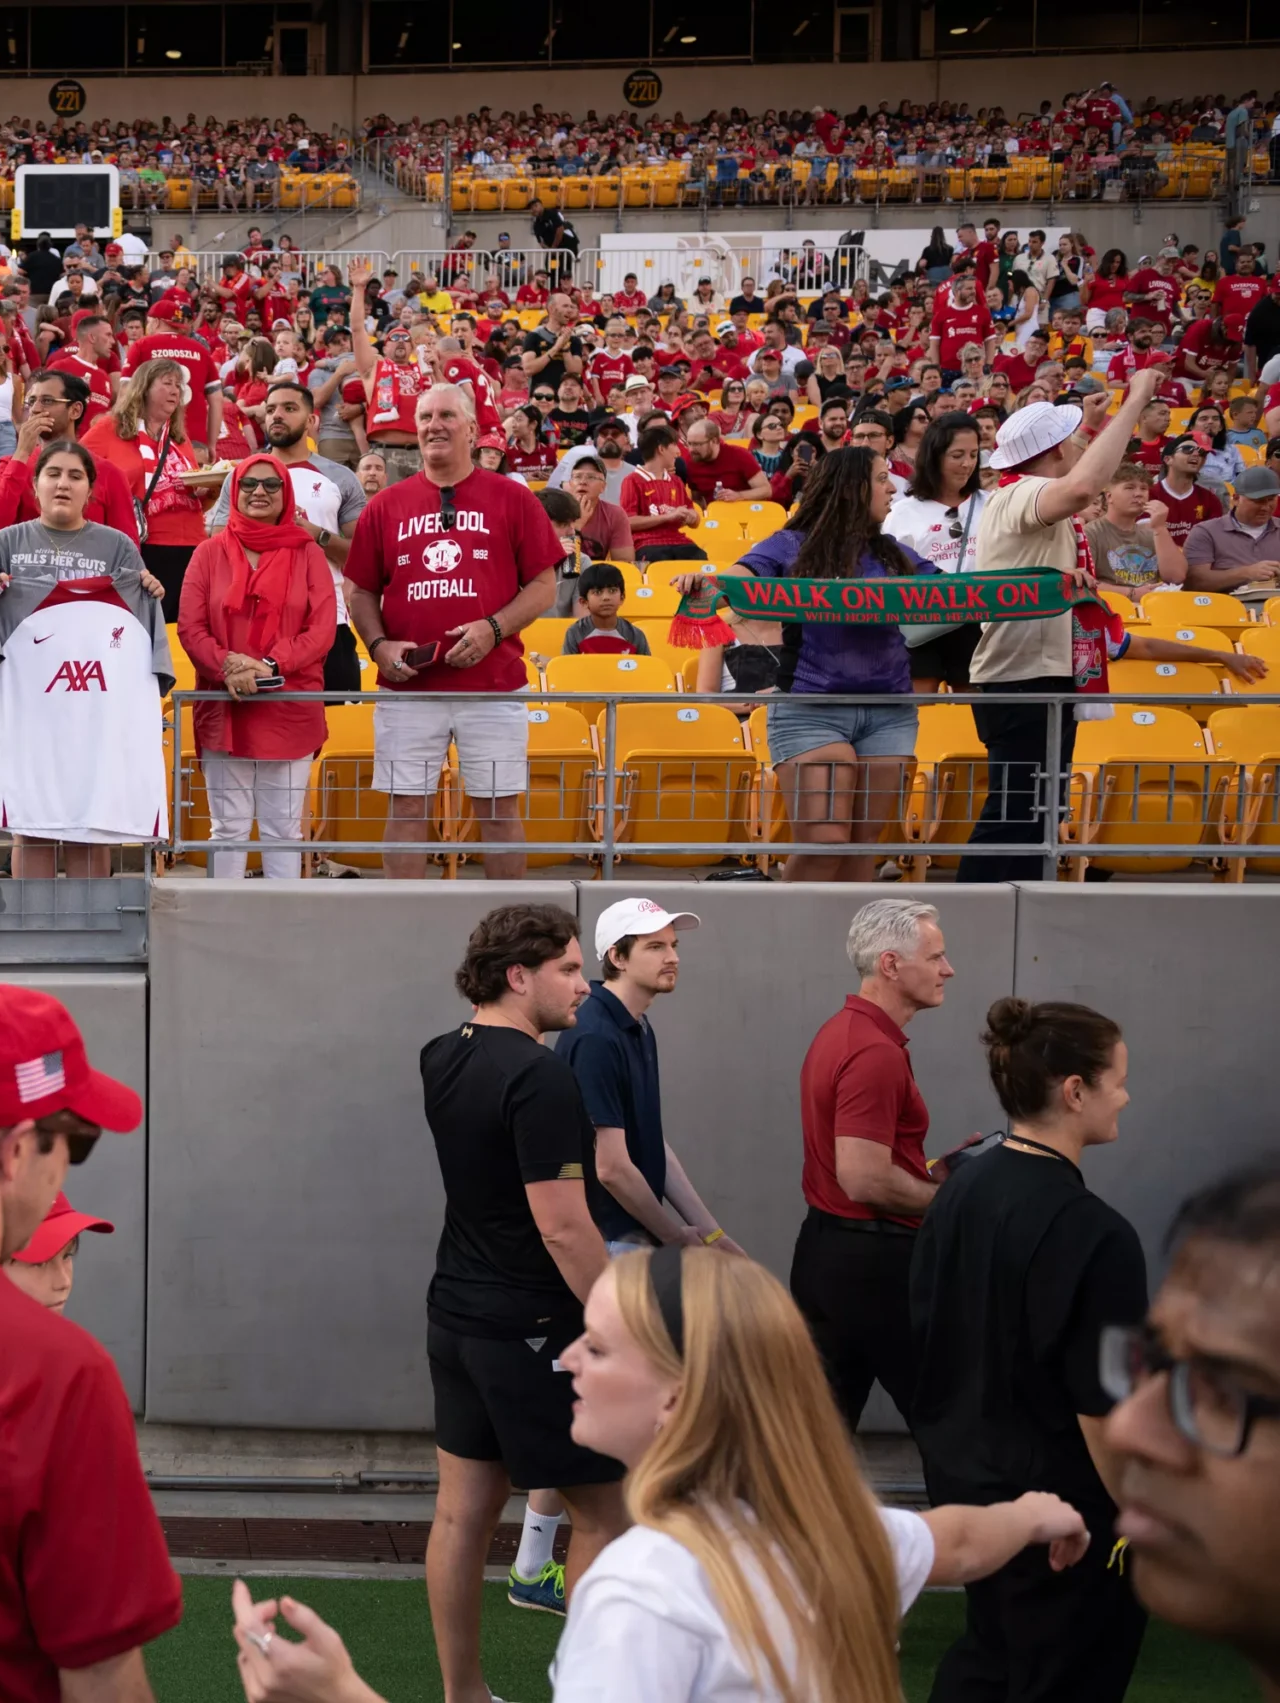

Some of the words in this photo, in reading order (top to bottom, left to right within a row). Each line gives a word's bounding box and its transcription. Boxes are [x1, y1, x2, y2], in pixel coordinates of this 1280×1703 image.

[56, 91, 80, 111] 221
[629, 81, 659, 102] 220
[398, 510, 490, 542] LIVEROOL
[11, 553, 47, 565] SPILLS
[50, 555, 73, 568] HER
[77, 557, 107, 573] GUTS
[397, 554, 411, 567] EST.
[472, 548, 489, 561] 1892
[407, 578, 478, 602] FOOTBALL
[742, 581, 833, 610] WALK
[840, 585, 885, 610] ON
[898, 584, 988, 610] WALK
[996, 581, 1040, 607] ON
[804, 611, 841, 623] WITH
[845, 611, 881, 623] HOPE
[886, 611, 900, 623] IN
[904, 611, 942, 623] YOUR
[945, 610, 992, 623] HEART
[44, 660, 109, 693] AXA
